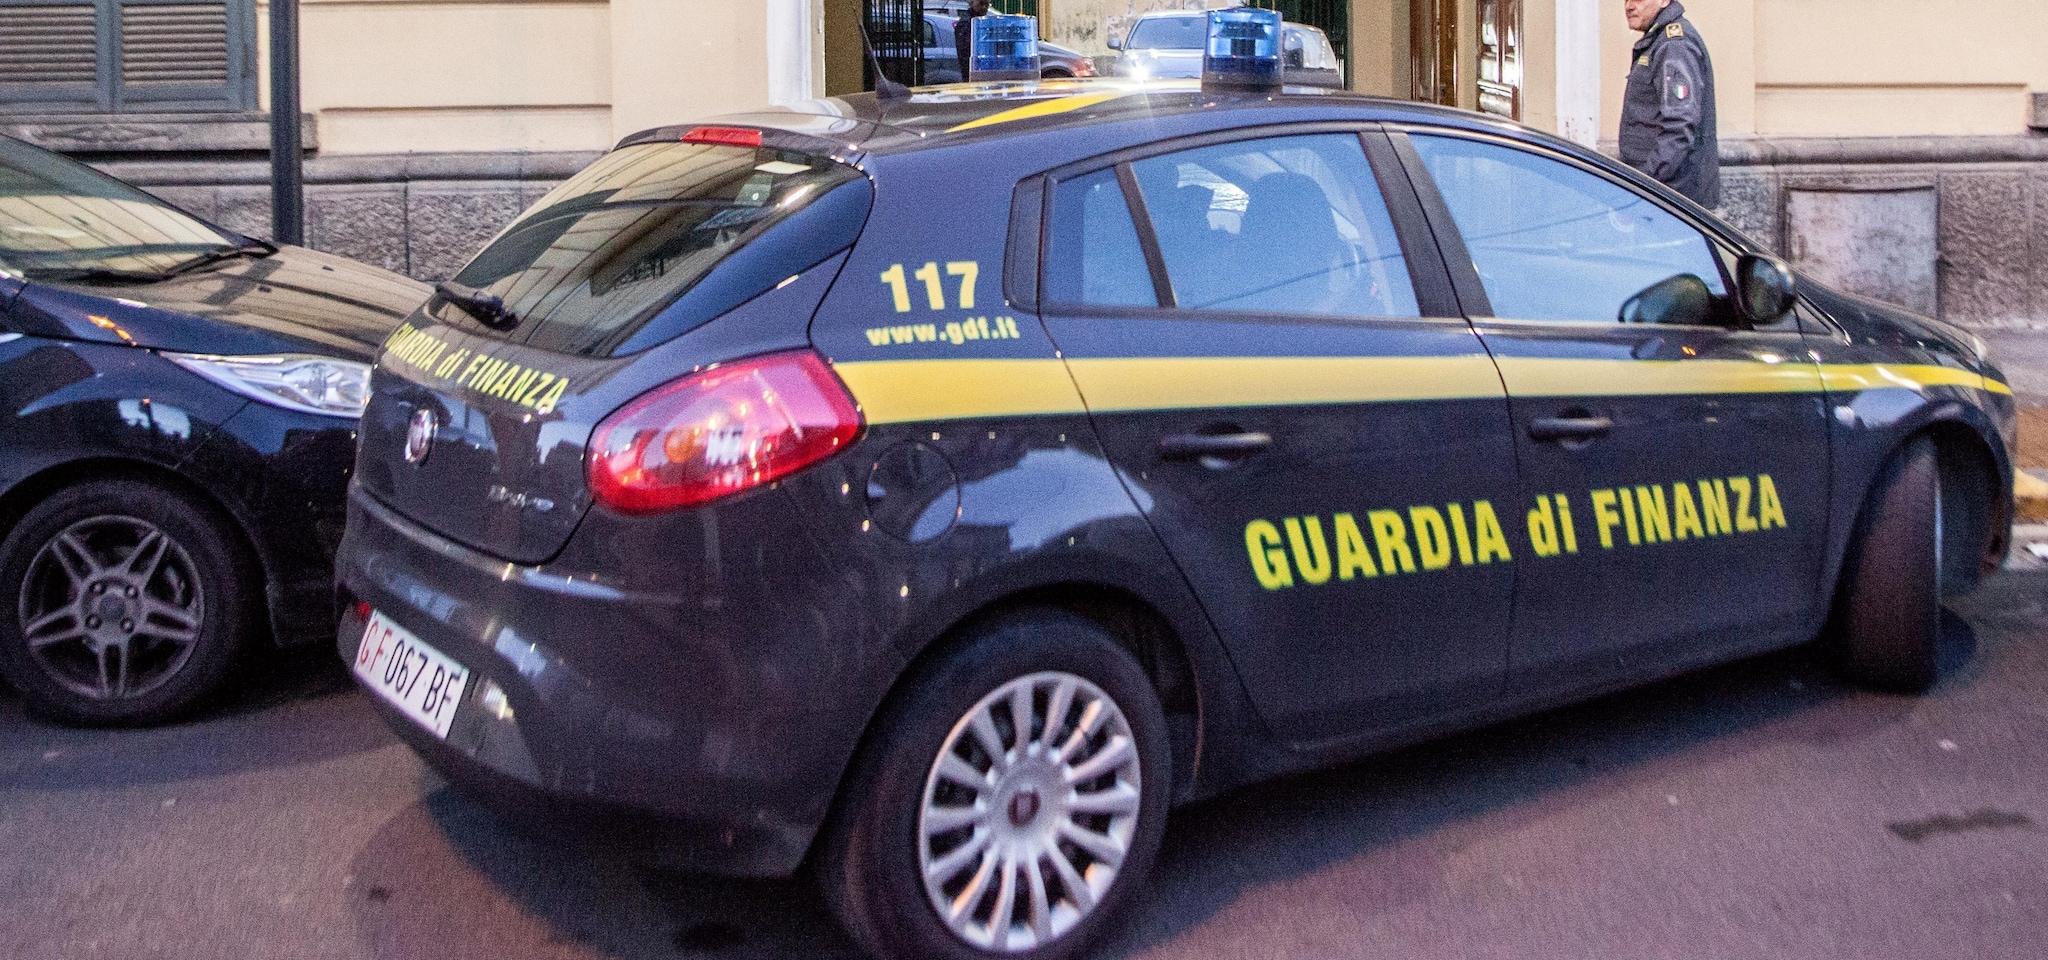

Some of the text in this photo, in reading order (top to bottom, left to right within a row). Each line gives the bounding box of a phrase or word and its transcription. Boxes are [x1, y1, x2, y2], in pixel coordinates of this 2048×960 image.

[880, 261, 979, 313] 117
[384, 321, 570, 414] GUARDIA di FINANZA
[866, 316, 1020, 346] www.gdf.it
[1244, 473, 1788, 591] GUARDIA di FINANZA
[384, 637, 429, 700] 067
[421, 663, 462, 720] BF
